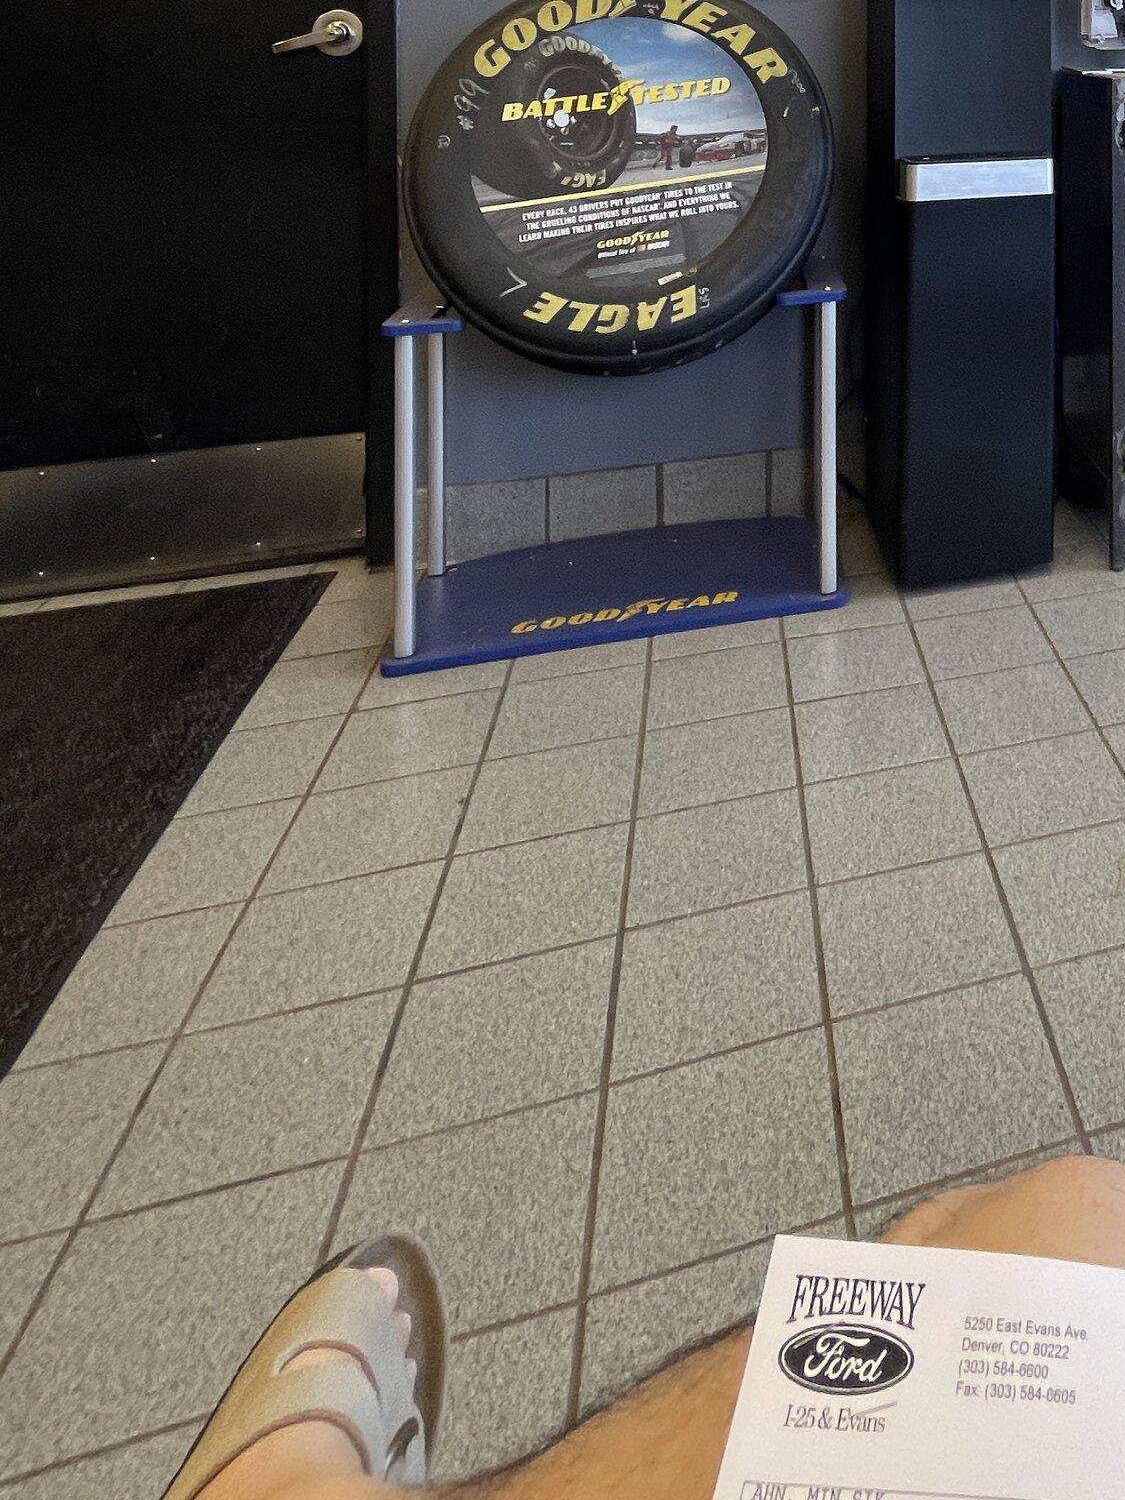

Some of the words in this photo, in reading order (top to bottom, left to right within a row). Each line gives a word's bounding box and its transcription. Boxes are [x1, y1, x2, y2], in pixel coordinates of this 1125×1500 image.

[502, 92, 609, 122] BATTLE
[631, 77, 731, 106] TESTED
[522, 210, 545, 221] EVERY
[568, 205, 578, 214] 43
[579, 201, 609, 212] DRIVERS
[610, 198, 624, 207] PUT
[664, 188, 683, 199] TIRES
[684, 187, 693, 196] TO
[694, 185, 707, 194] THE
[708, 183, 724, 192] TEST
[724, 181, 733, 190] IN
[526, 221, 540, 230] THE
[541, 216, 577, 229] GRUELING
[578, 209, 620, 223] CONDITIONS
[621, 207, 630, 216] OF
[663, 200, 678, 210] AND
[678, 193, 719, 207] EVERYTHING
[719, 191, 731, 200] WE
[518, 231, 542, 243] LEARN
[543, 227, 571, 239] MAKING
[572, 224, 593, 235] THEIR
[594, 220, 614, 231] TIRES
[615, 214, 648, 228] INSPIRES
[648, 211, 667, 222] WHAT
[668, 209, 679, 219] WE
[680, 206, 698, 217] ROLL
[698, 204, 714, 214] INTO
[597, 230, 670, 249] GOODYEAR
[523, 285, 697, 334] EAGLE
[511, 591, 739, 634] GOODYEAR
[786, 1274, 926, 1330] FREEWAY
[964, 1316, 993, 1331] 5250
[996, 1318, 1022, 1333] East
[1025, 1320, 1061, 1337] Evans
[803, 1331, 887, 1383] Ford
[958, 1359, 990, 1378] (303)
[993, 1360, 1049, 1379] 584-6600
[1009, 1340, 1030, 1355] CO
[1033, 1342, 1070, 1359] 80222
[984, 1383, 1016, 1402] (303)
[1020, 1384, 1076, 1405] 584-6605
[818, 1407, 832, 1430] &
[834, 1406, 887, 1434] Evans
